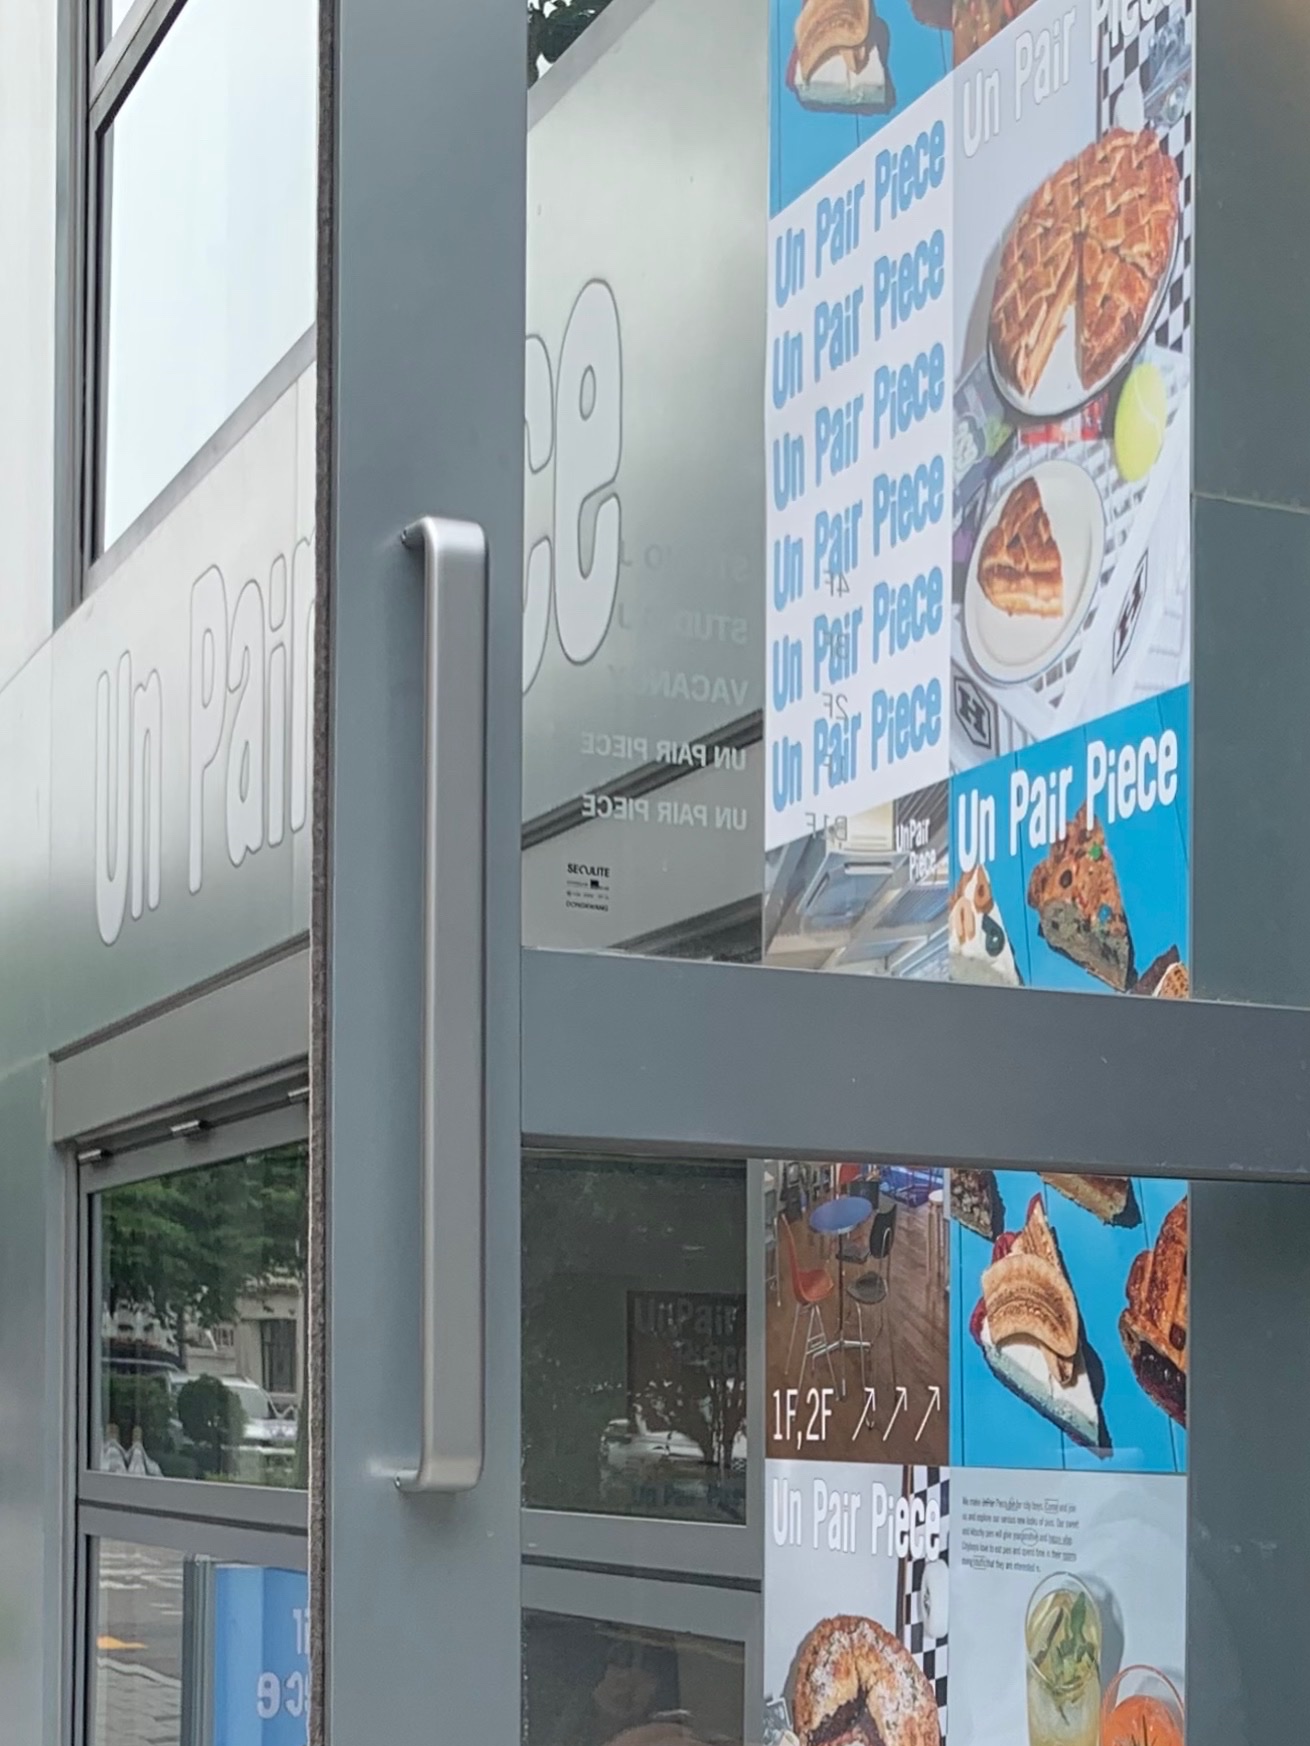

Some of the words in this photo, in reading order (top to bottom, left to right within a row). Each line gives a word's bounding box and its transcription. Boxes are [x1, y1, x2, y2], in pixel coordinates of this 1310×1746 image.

[963, 68, 999, 158] Un
[1015, 6, 1075, 121] Pair
[776, 228, 804, 307] Un
[815, 179, 864, 278] Pair
[875, 120, 945, 231] Piece
[773, 331, 803, 410] Un
[814, 284, 863, 383] Pair
[874, 229, 945, 341] Piece
[773, 433, 803, 511] Un
[815, 394, 863, 487] Pair
[873, 342, 945, 448] Piece
[774, 535, 802, 611] Un
[814, 509, 862, 589] Pair
[873, 455, 943, 556] Piece
[773, 635, 802, 712] Un
[814, 608, 862, 692] Pair
[873, 566, 943, 663] Piece
[96, 650, 162, 946] Un
[189, 528, 316, 895] Pair
[773, 735, 801, 812] Un
[814, 712, 862, 797] Pair
[871, 677, 941, 771] Piece
[958, 790, 995, 871] Un
[1010, 766, 1072, 856] Pair
[1087, 729, 1177, 829] Piece
[910, 849, 936, 880] Piece
[772, 1387, 834, 1450] 1F,2F
[773, 1477, 801, 1547] Un
[813, 1477, 861, 1554] Pair
[871, 1480, 940, 1561] Piece
